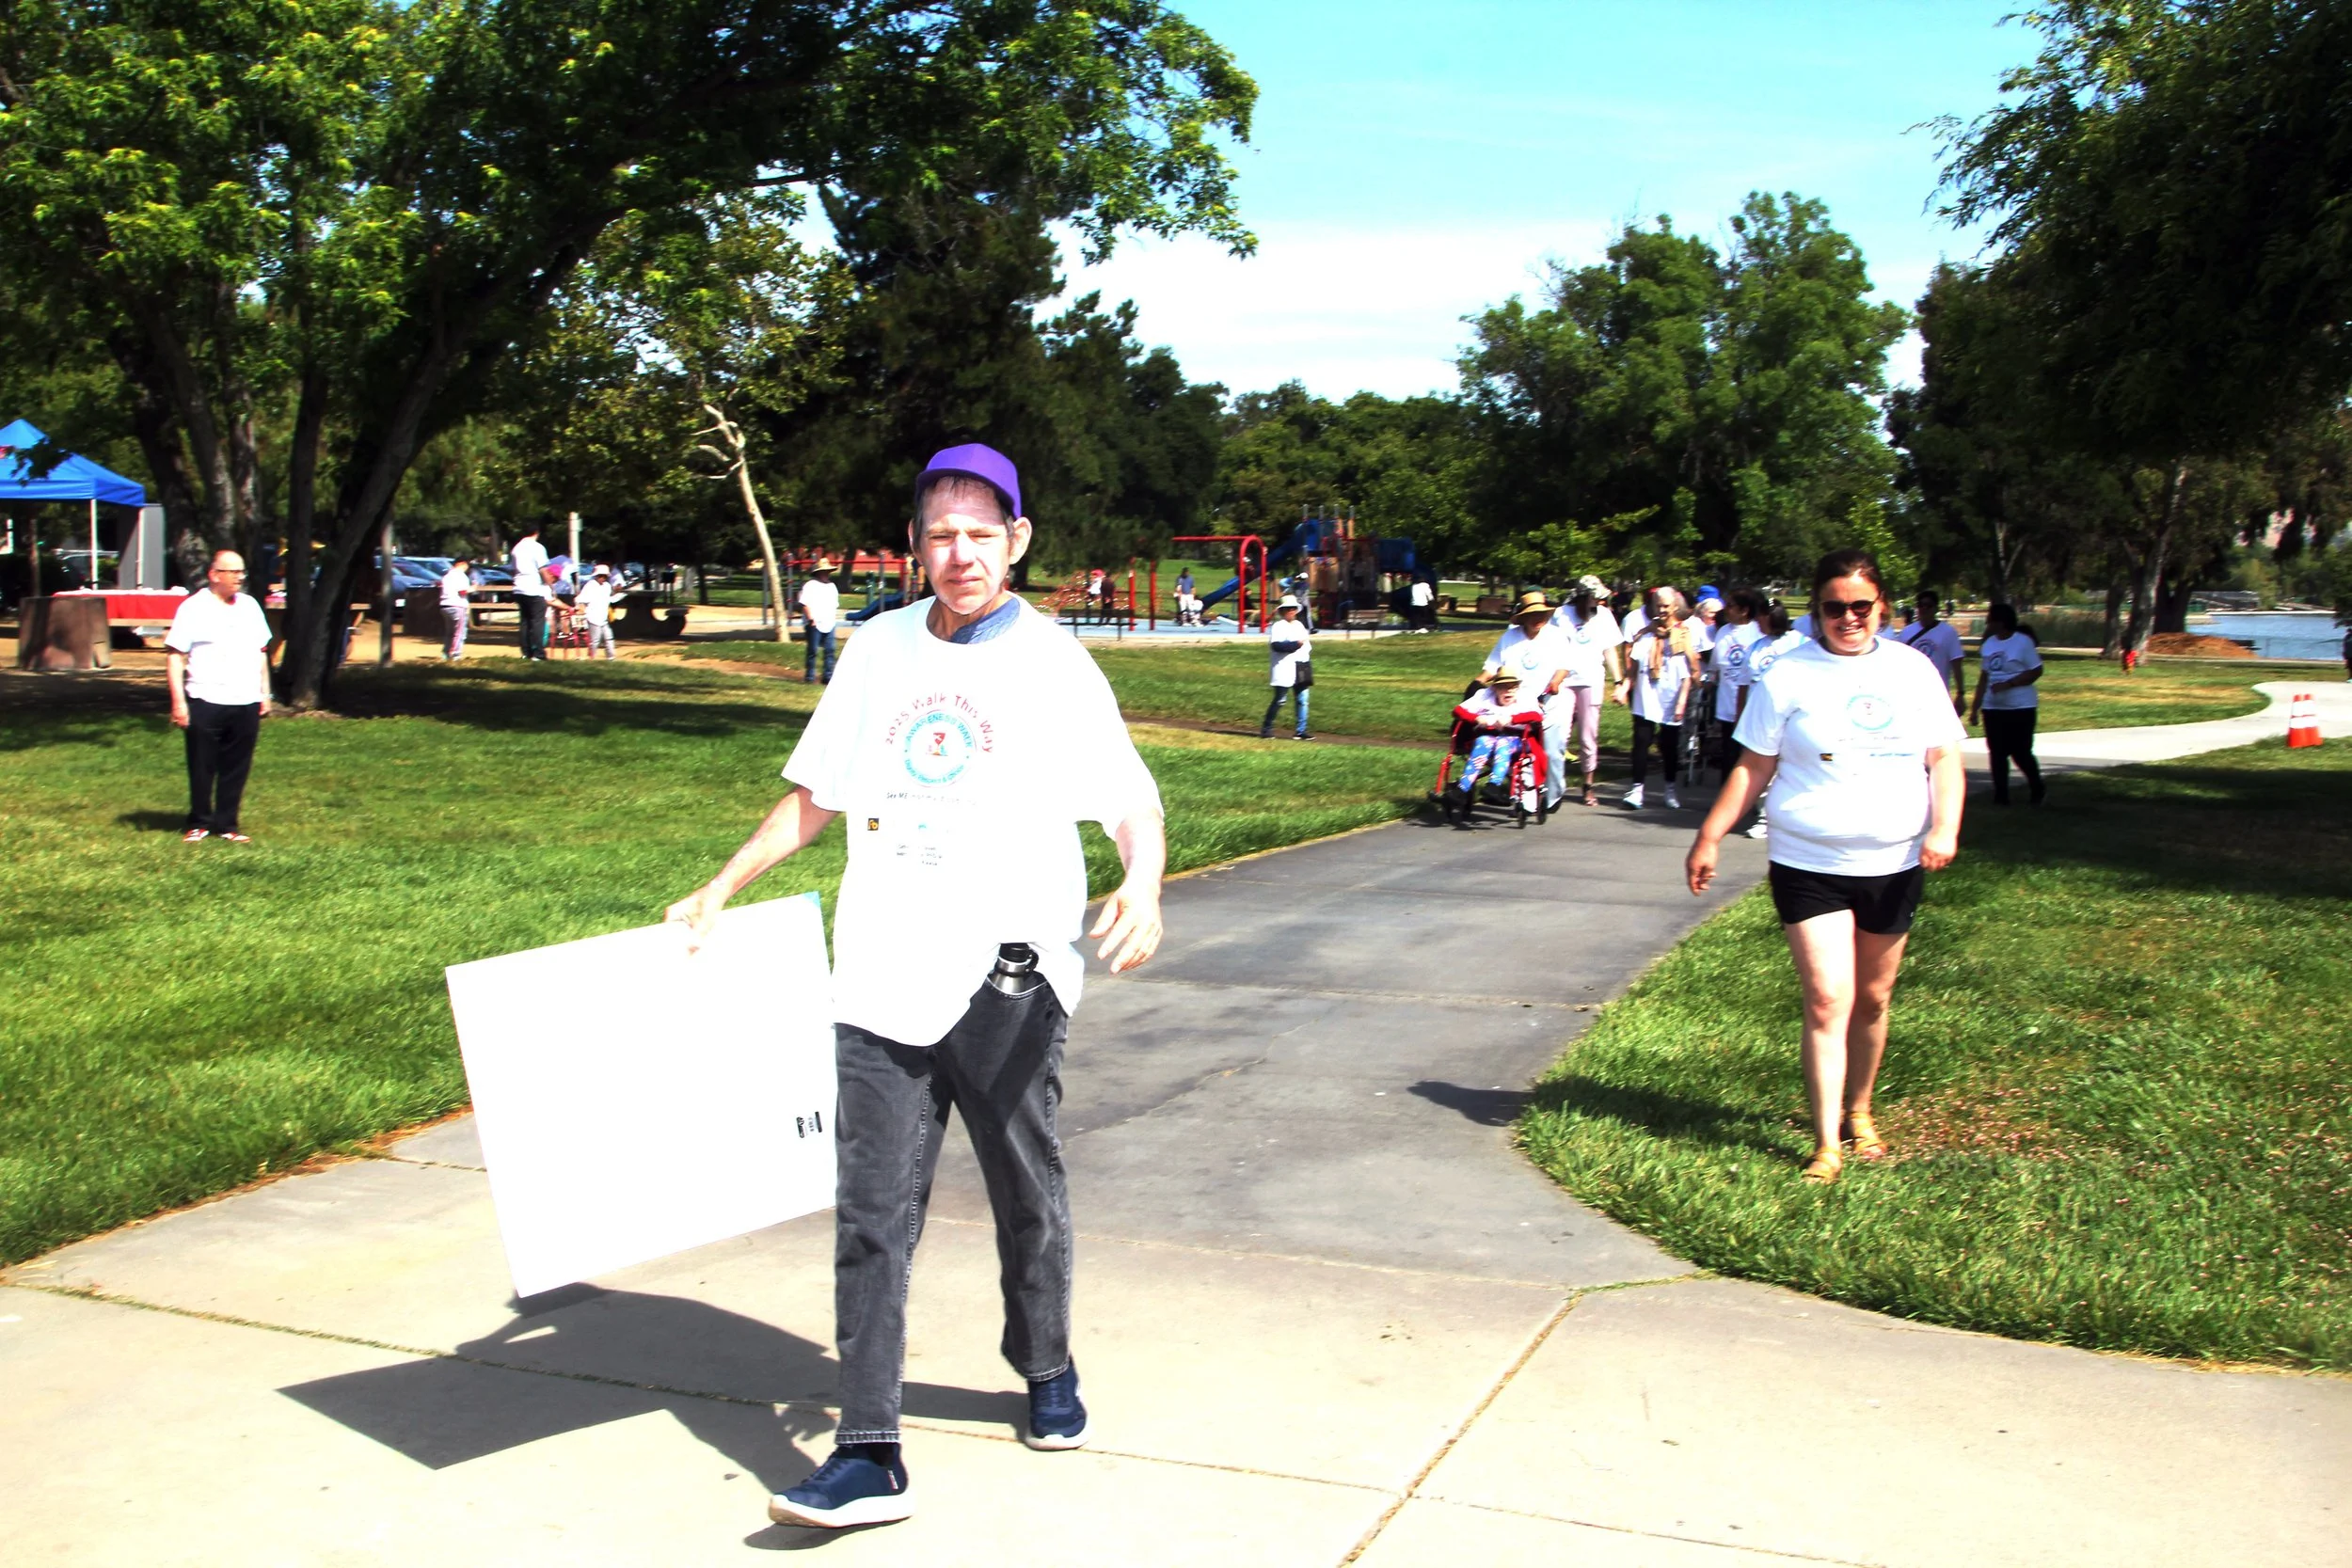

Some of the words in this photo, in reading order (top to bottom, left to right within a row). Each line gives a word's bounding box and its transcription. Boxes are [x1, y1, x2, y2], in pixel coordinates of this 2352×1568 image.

[885, 711, 910, 744] 2025
[912, 692, 946, 710] Walk
[955, 695, 977, 719] This
[979, 720, 994, 753] Way
[958, 722, 973, 748] WALK
